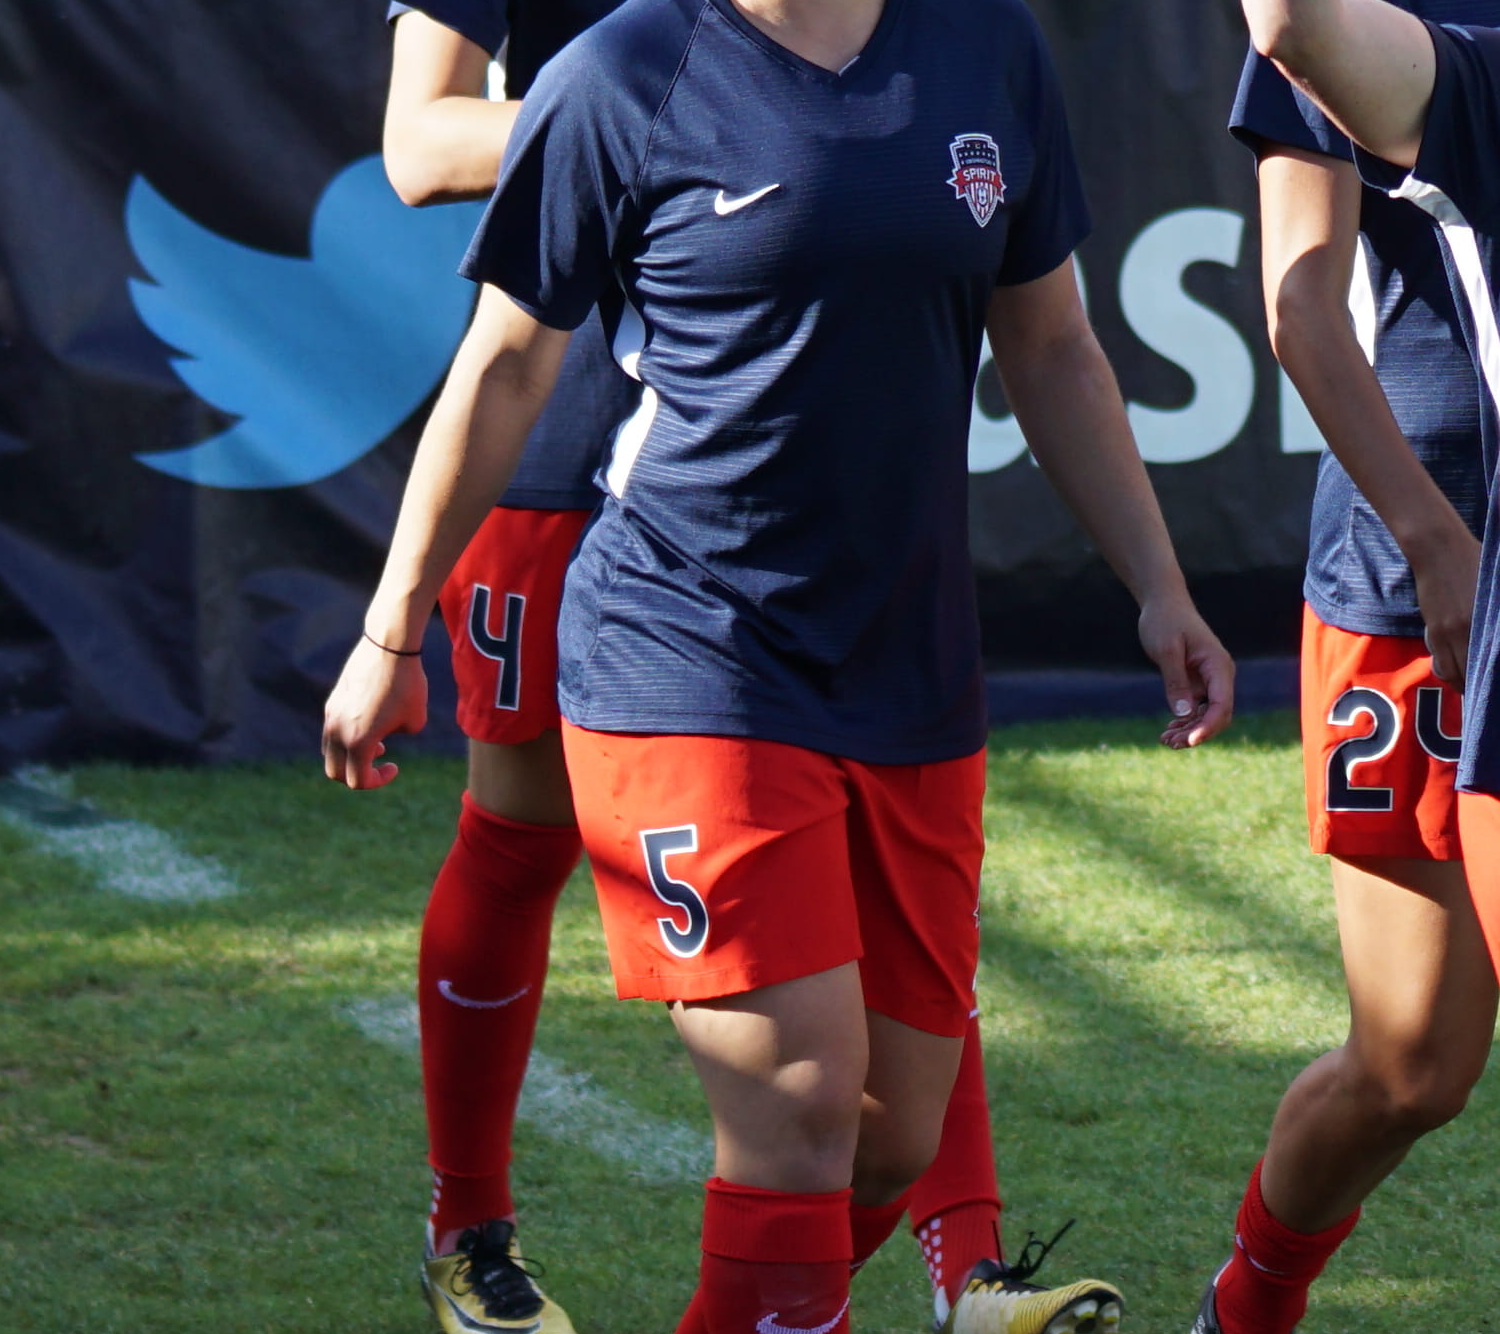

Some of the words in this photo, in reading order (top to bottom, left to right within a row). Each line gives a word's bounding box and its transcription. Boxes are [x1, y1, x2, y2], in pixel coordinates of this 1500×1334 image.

[962, 167, 998, 183] SPIRIT
[468, 582, 526, 711] 4
[639, 823, 710, 959] 5
